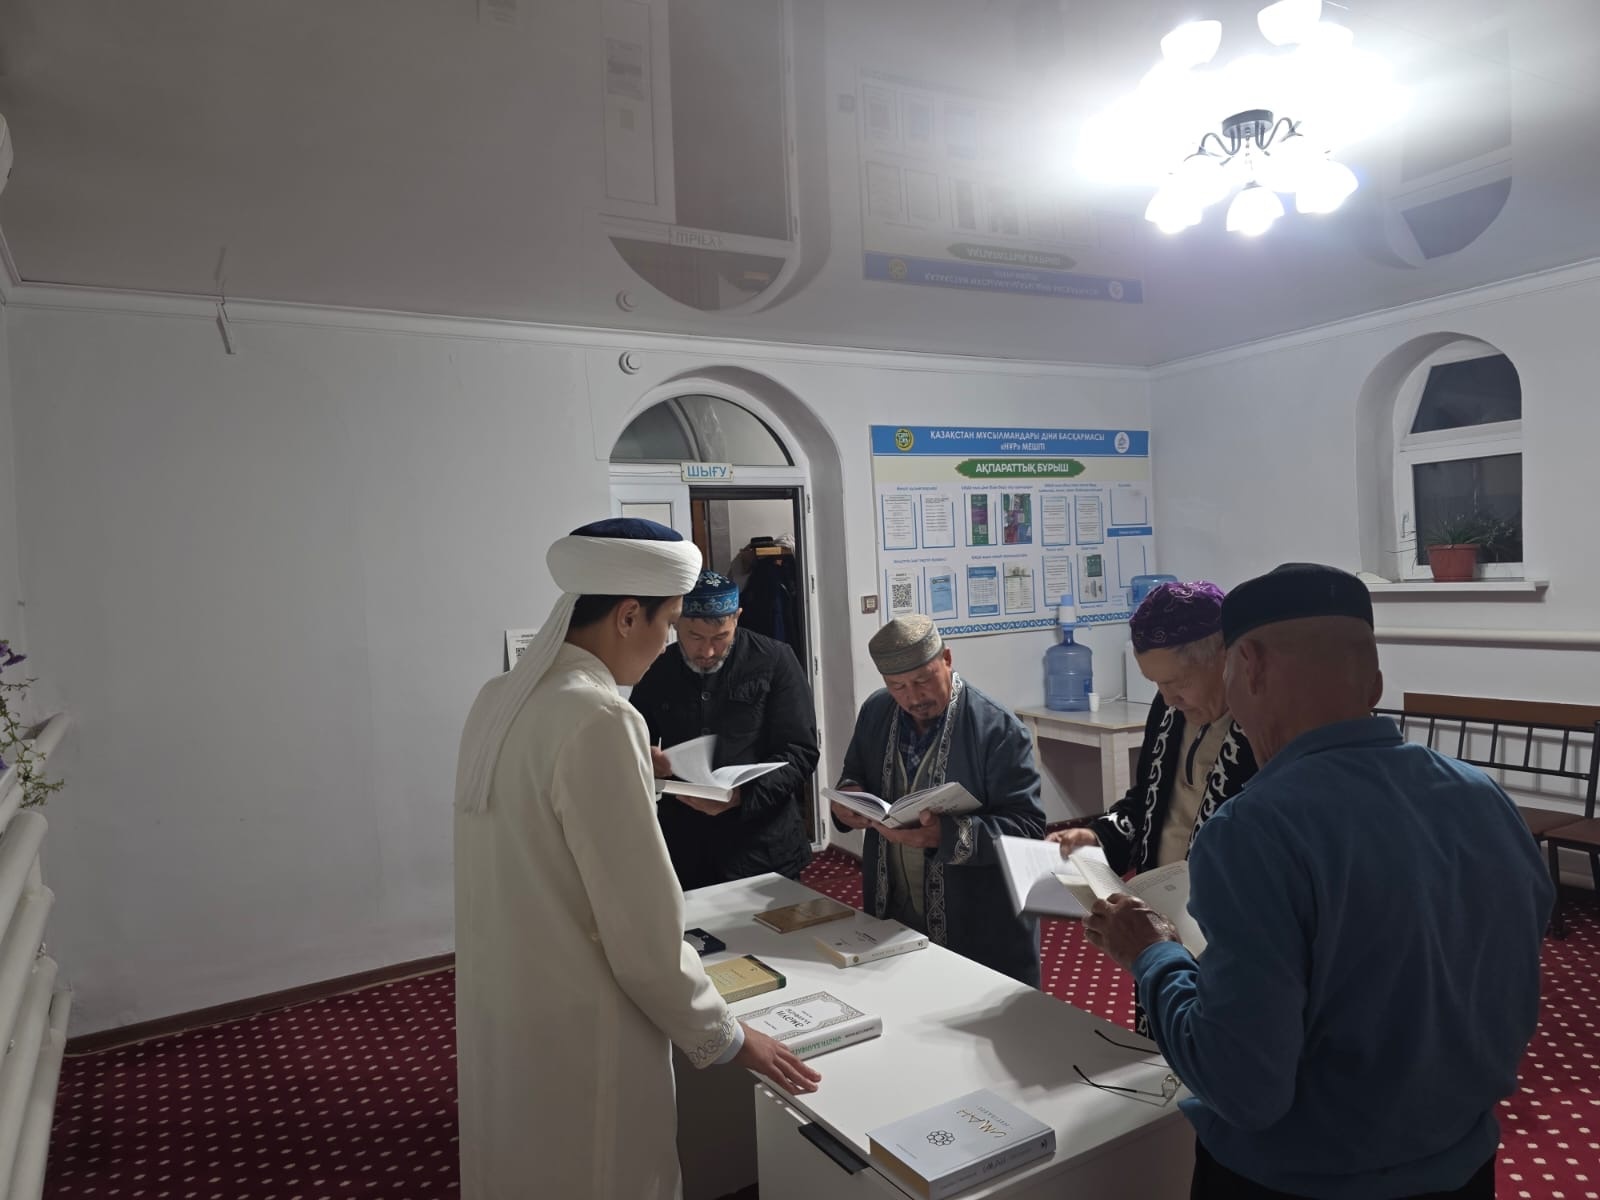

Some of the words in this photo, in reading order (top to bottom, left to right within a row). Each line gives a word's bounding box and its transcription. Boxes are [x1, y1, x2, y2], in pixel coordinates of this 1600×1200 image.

[930, 430, 975, 440] ҚАЗАҚСТАН
[976, 431, 1040, 441] МҰСЫЛМАНДАРЫ
[687, 465, 727, 478] ШЫҒУ
[975, 463, 1036, 475] АҚПАРАТТЫҚ
[1037, 463, 1069, 473] БҰРЫШ
